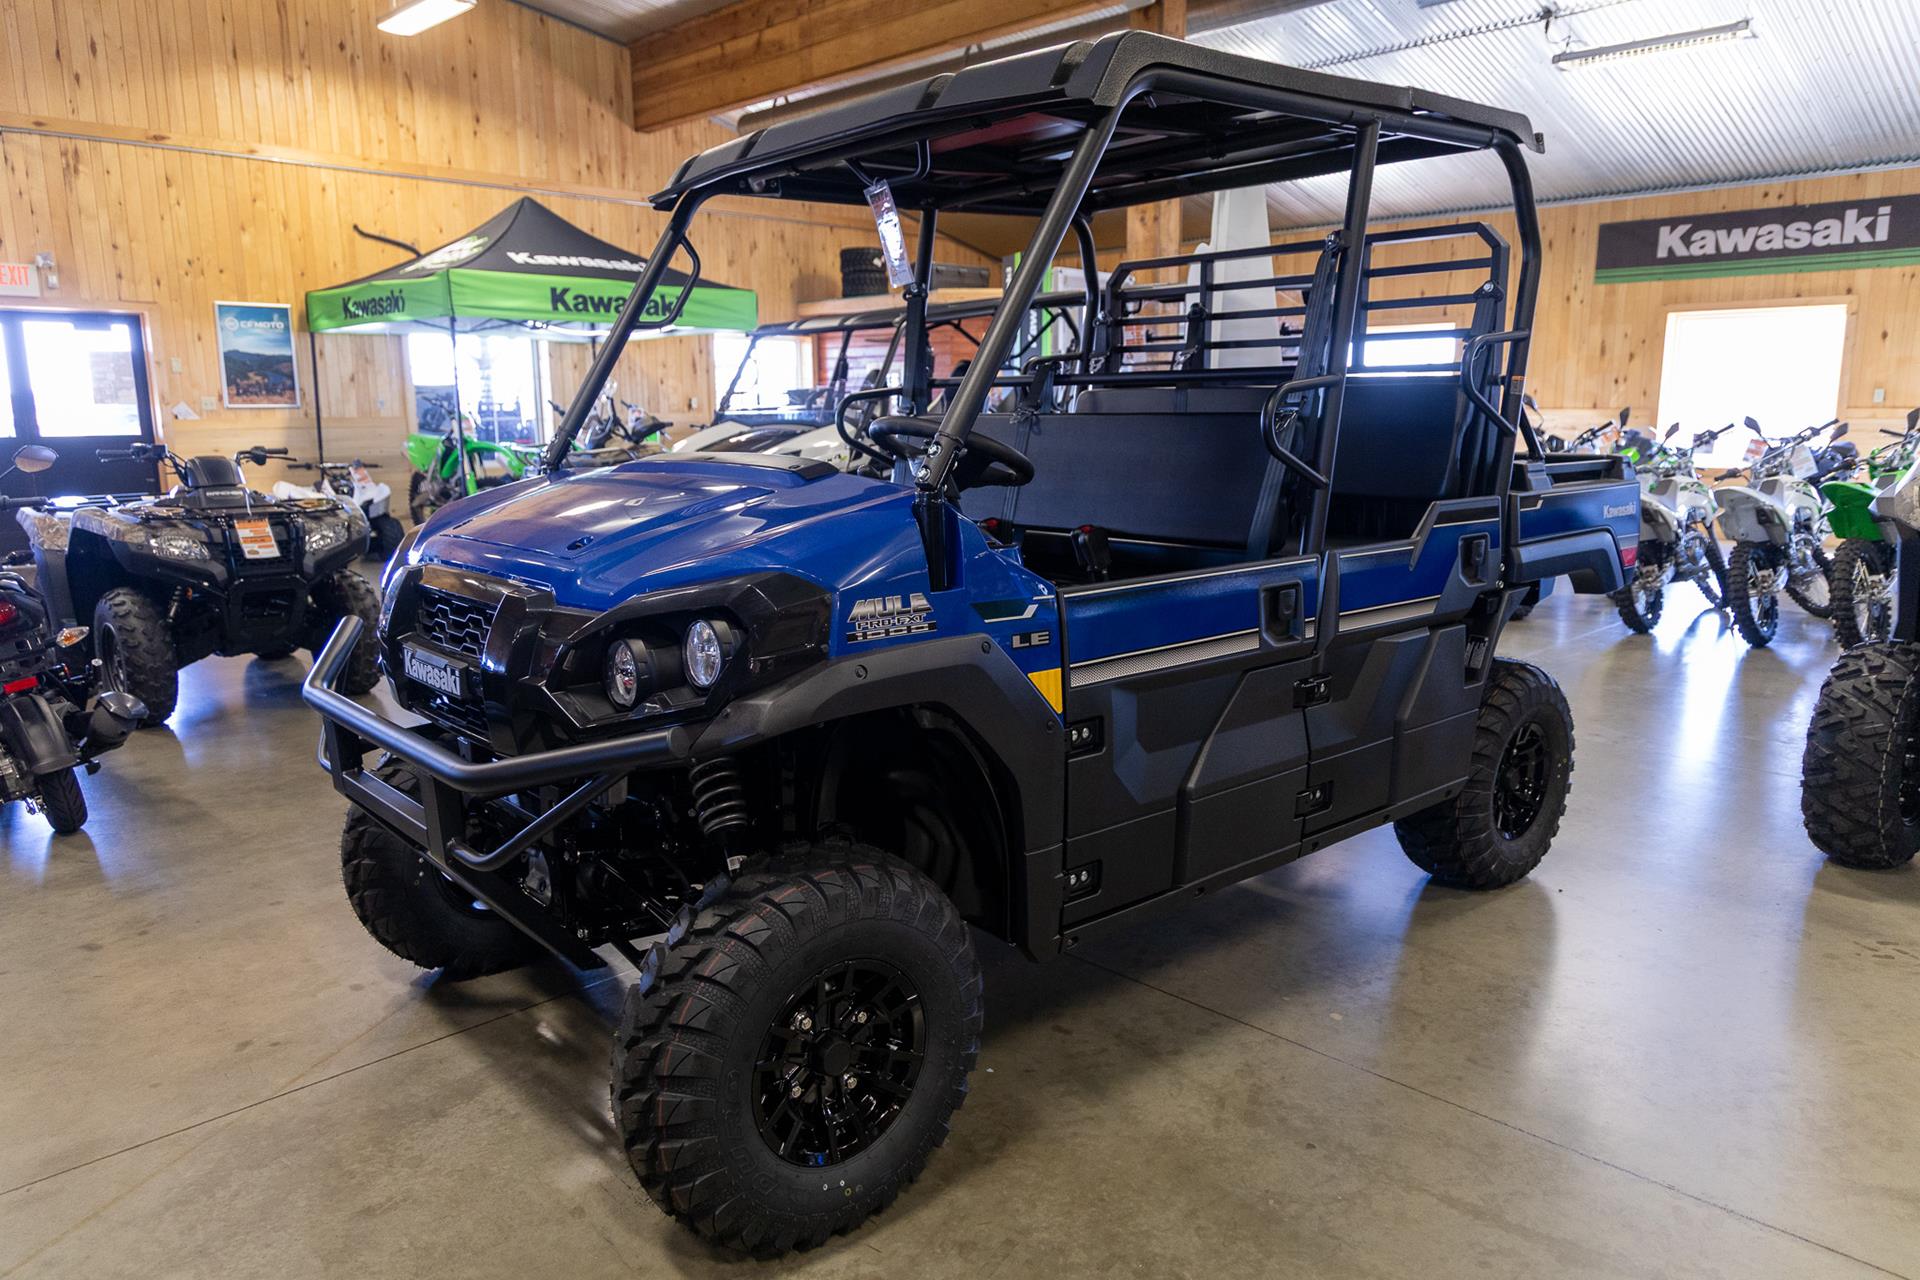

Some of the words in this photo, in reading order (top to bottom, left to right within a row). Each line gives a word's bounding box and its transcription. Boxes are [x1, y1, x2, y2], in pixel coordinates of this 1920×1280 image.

[1656, 205, 1892, 258] Kawasaki
[0, 264, 30, 287] EXIT
[341, 289, 406, 320] Kawasaki
[549, 286, 685, 318] Kawaak
[239, 320, 285, 330] CFMOTO
[1603, 501, 1636, 519] Kawasaki
[847, 592, 934, 623] MULE
[856, 623, 929, 641] 1000
[1012, 632, 1050, 649] LE
[403, 648, 461, 696] Kawasaki
